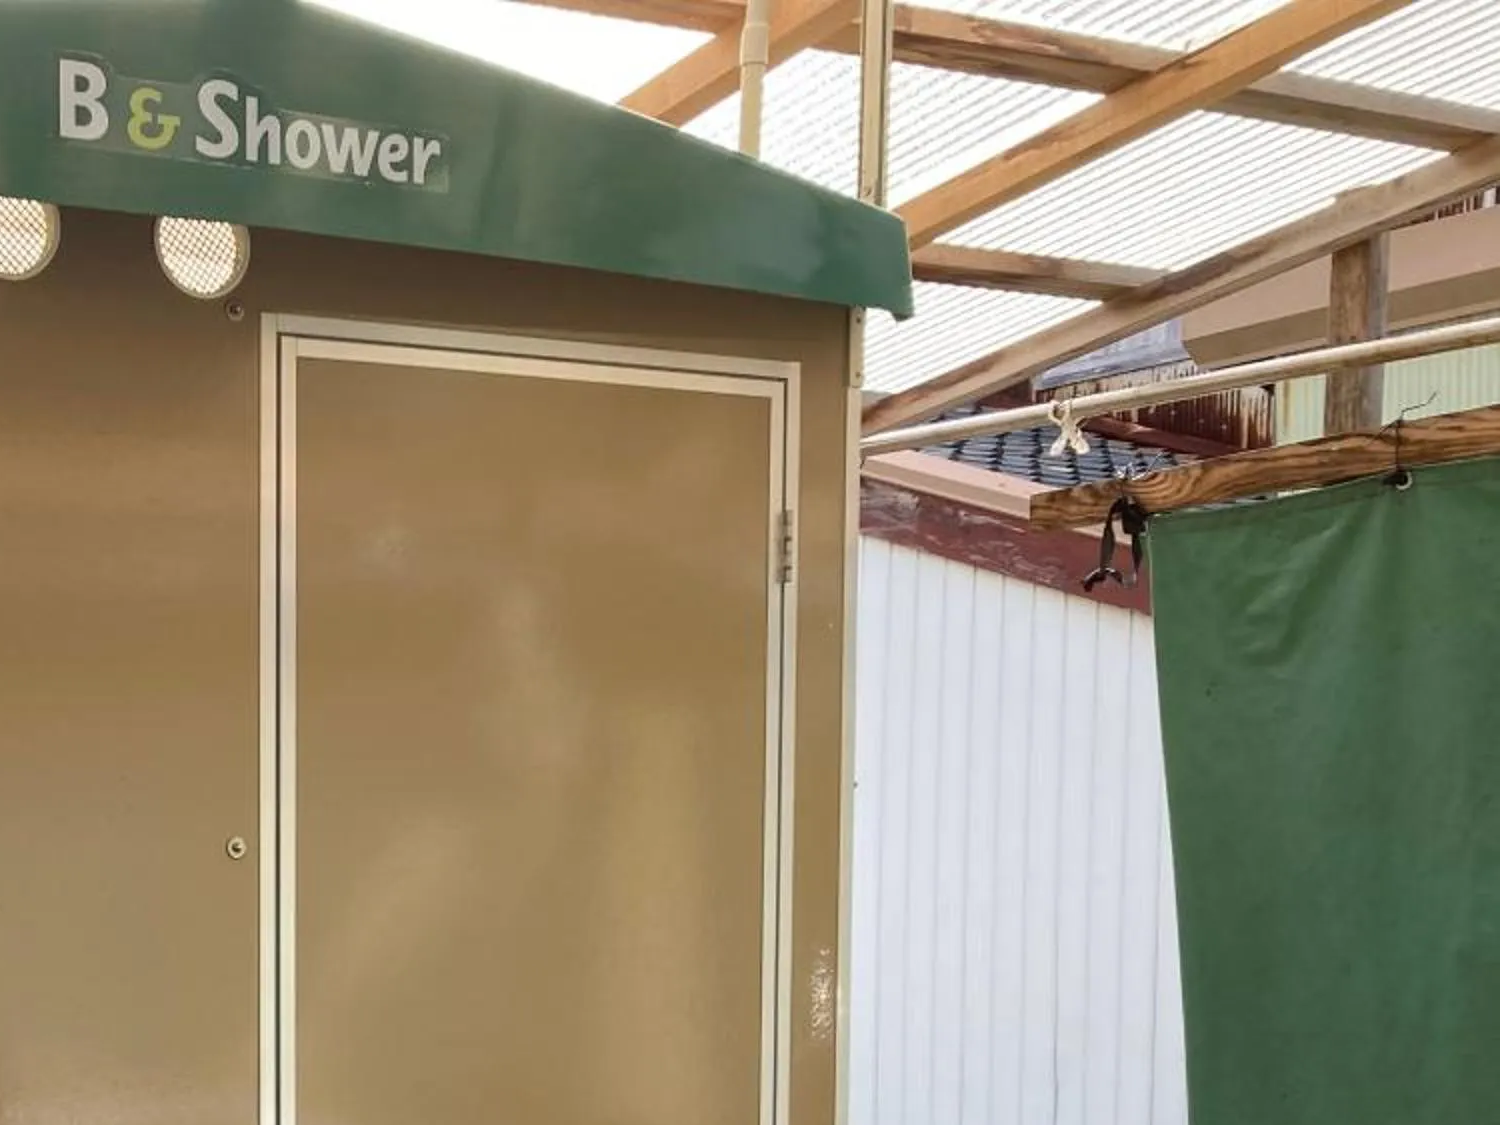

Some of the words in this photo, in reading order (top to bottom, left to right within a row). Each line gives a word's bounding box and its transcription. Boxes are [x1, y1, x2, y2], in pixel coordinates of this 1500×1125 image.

[58, 57, 110, 142] B
[127, 86, 181, 150] &
[194, 77, 442, 185] Shower
